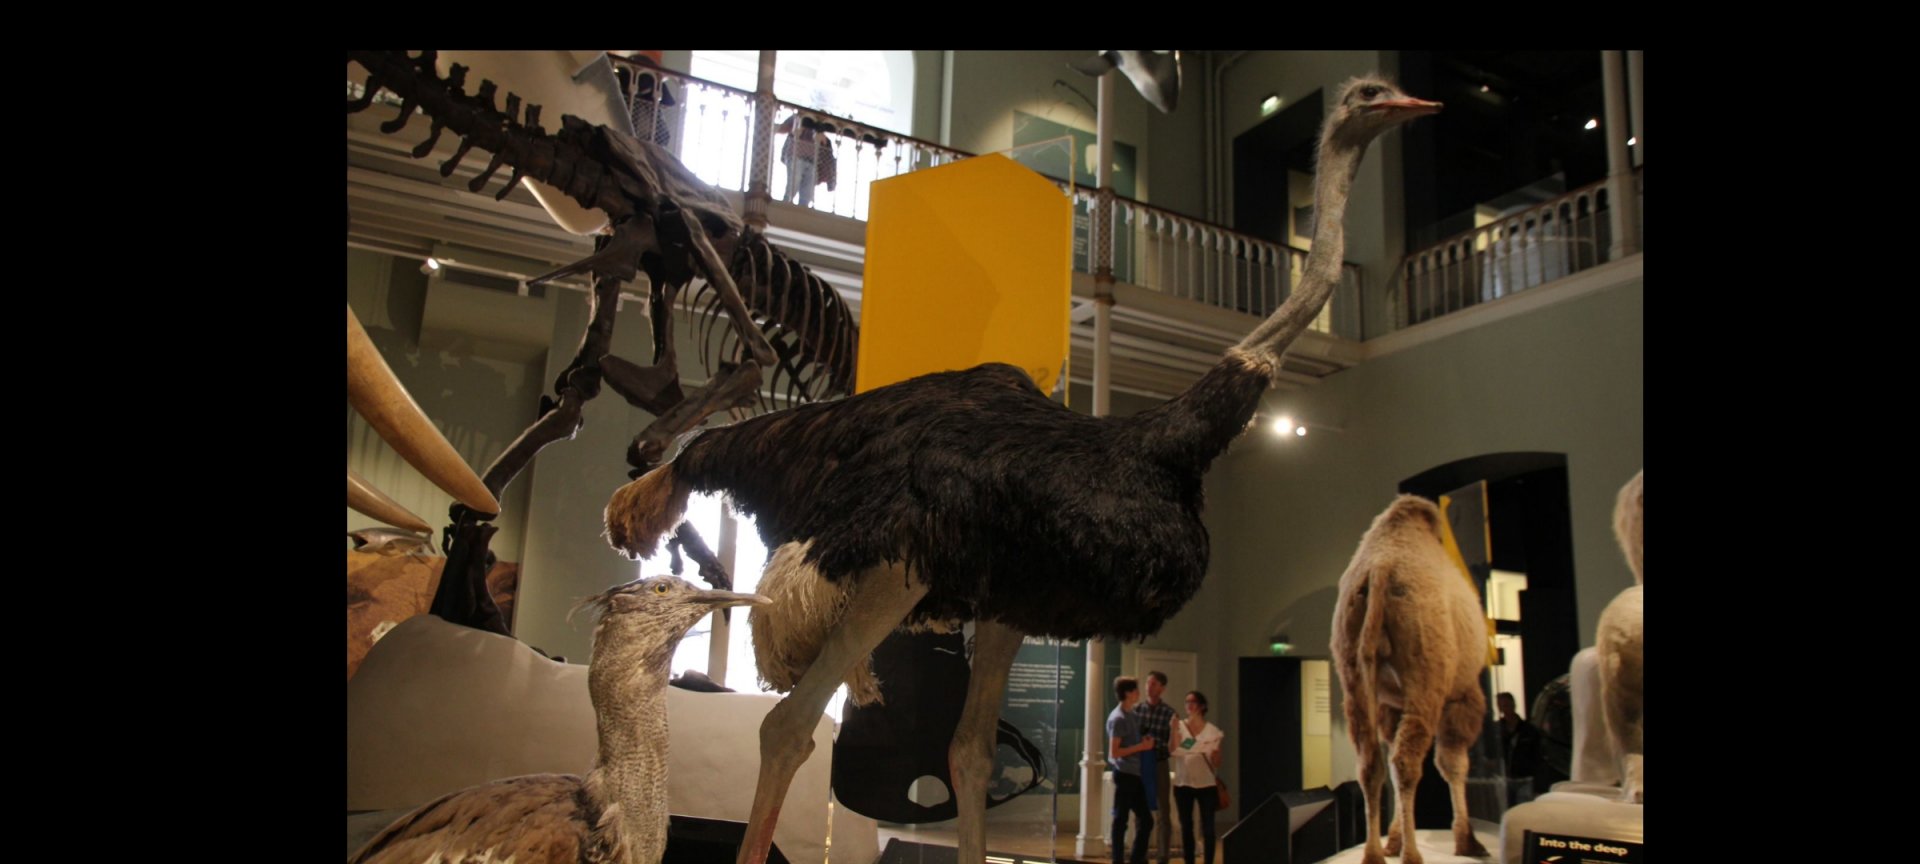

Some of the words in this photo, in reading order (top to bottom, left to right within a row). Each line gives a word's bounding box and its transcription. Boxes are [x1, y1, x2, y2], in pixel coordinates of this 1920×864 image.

[1539, 837, 1567, 848] Into
[1568, 840, 1591, 851] the
[1593, 843, 1628, 856] deep
